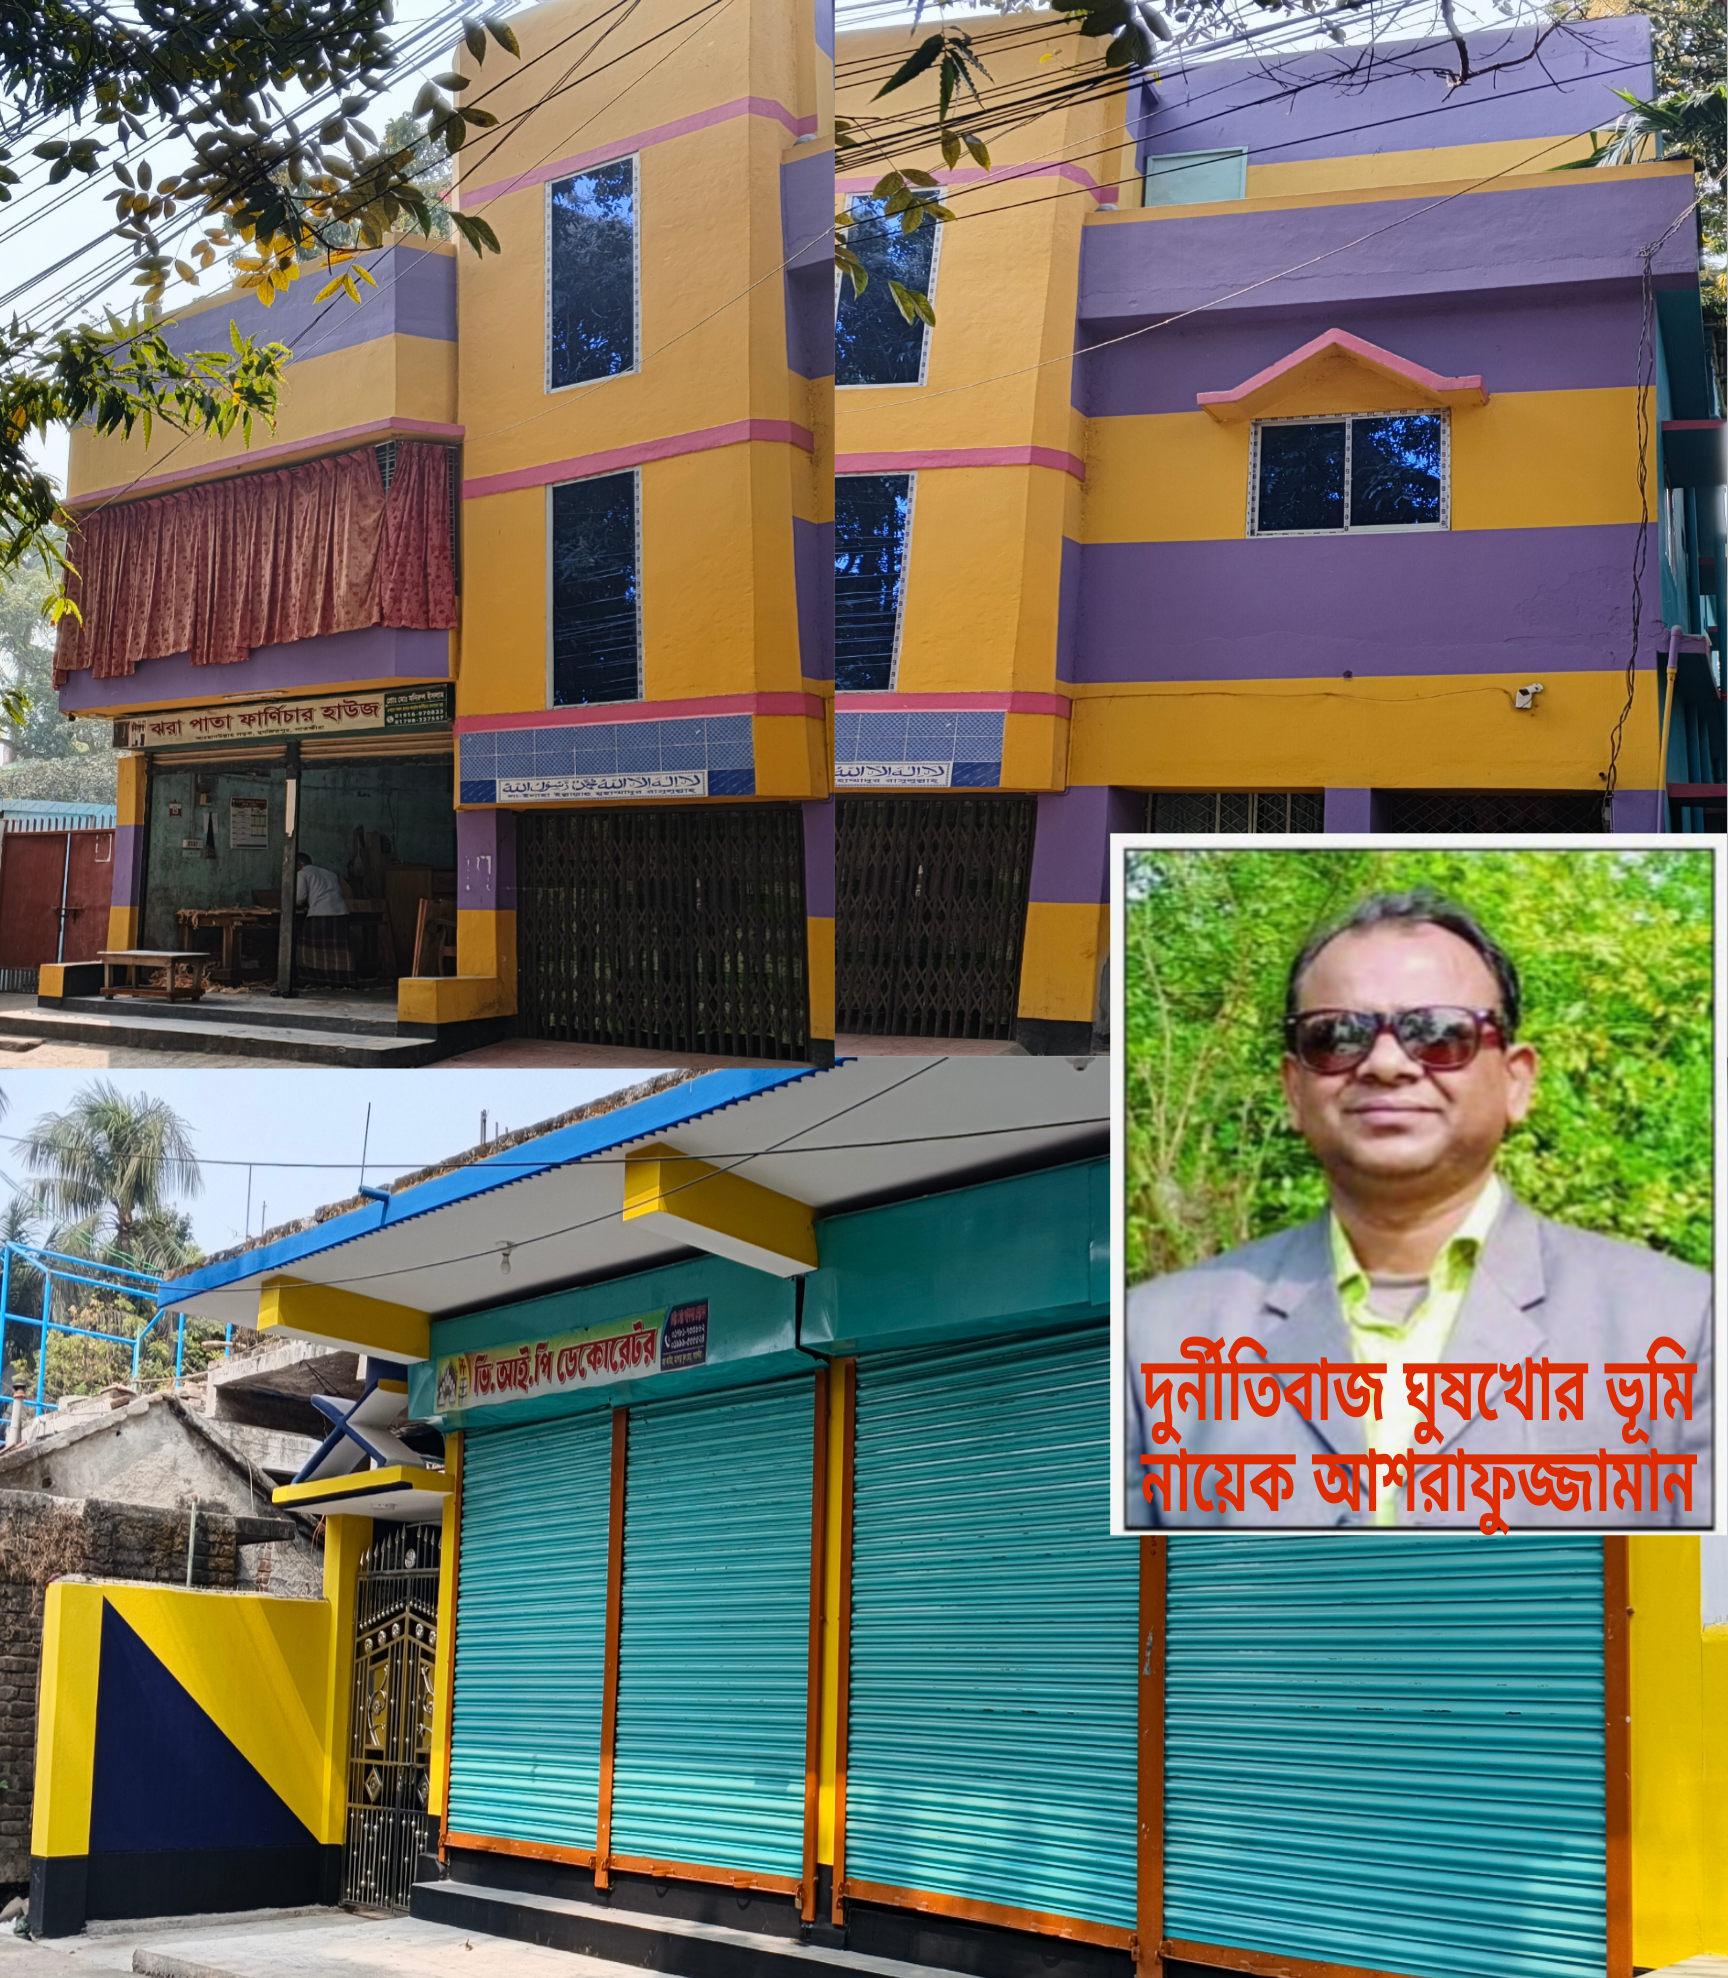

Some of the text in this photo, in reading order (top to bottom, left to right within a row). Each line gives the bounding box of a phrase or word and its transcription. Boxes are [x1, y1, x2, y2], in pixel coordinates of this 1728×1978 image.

[150, 719, 182, 737] ঝরা
[189, 714, 234, 733] পাতা
[321, 699, 382, 722] হাউজ
[557, 1321, 660, 1384] ডেকোরেটর
